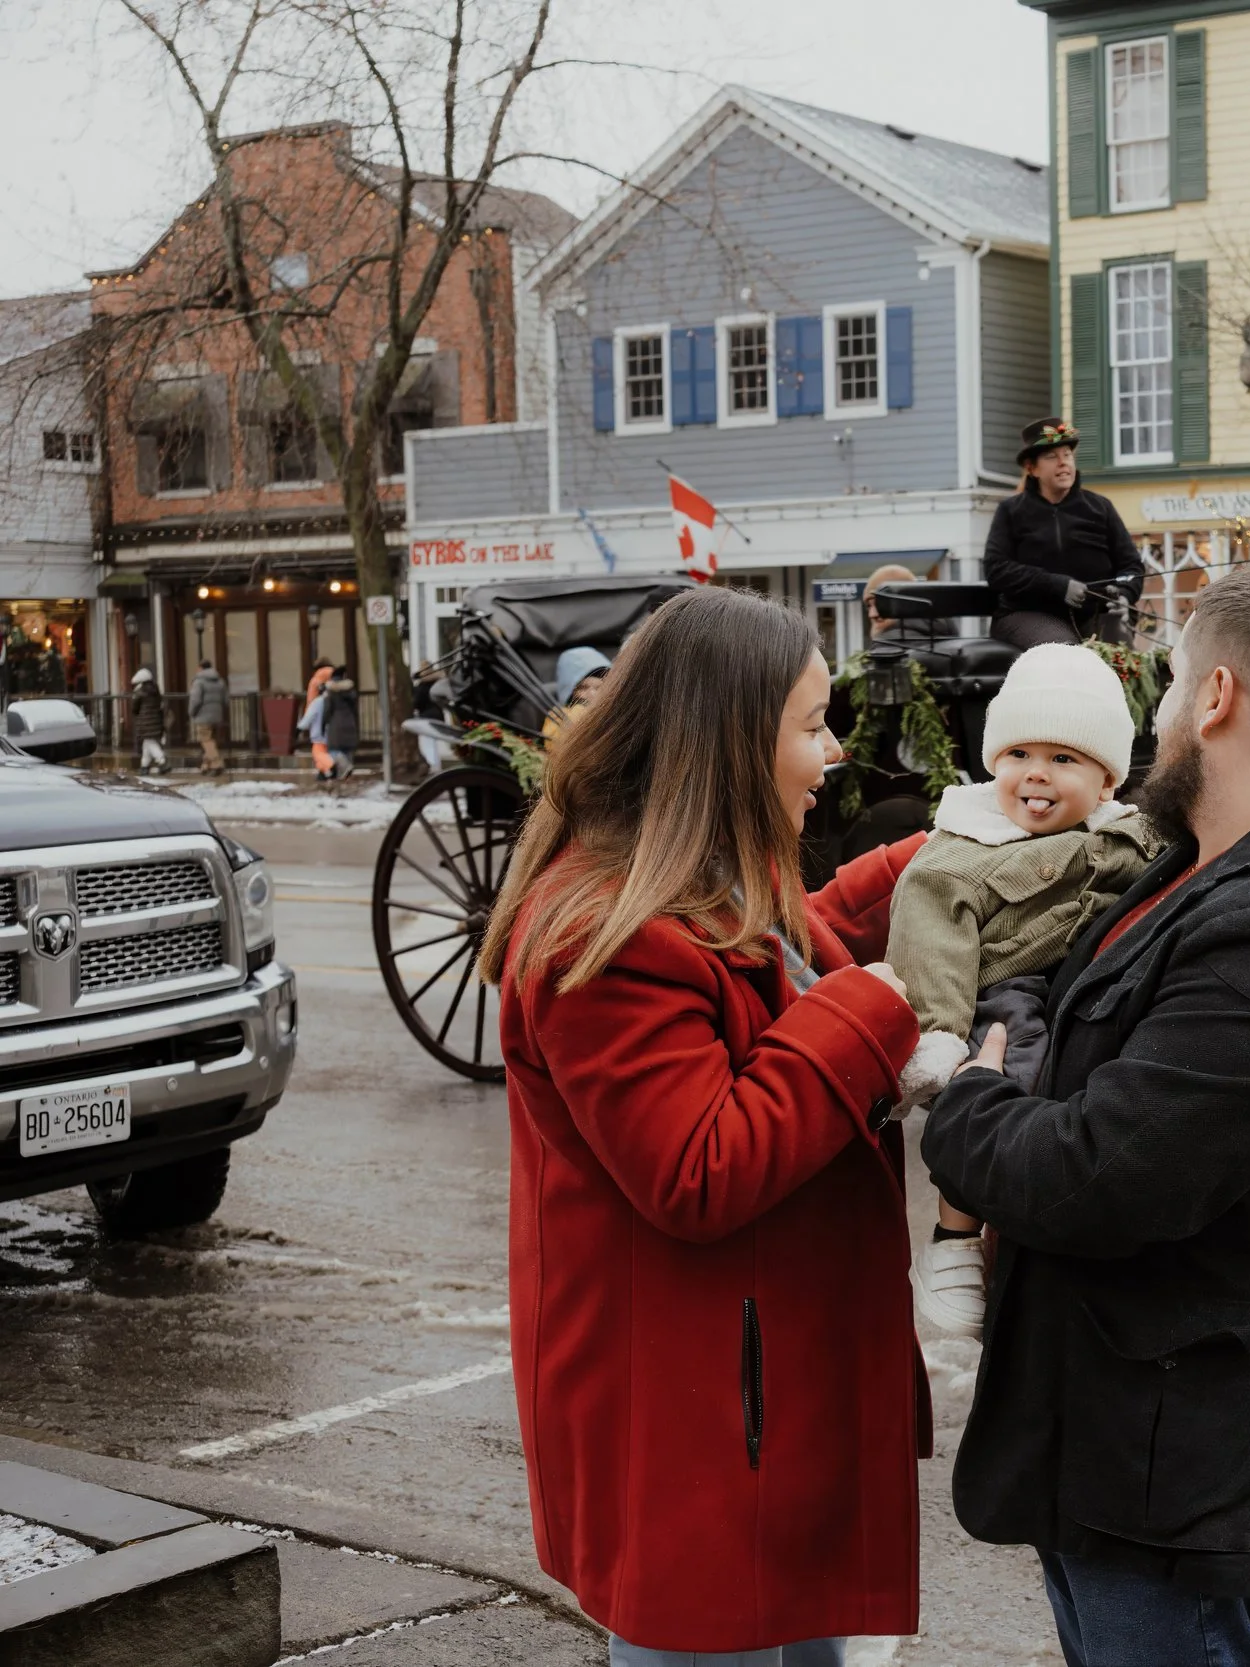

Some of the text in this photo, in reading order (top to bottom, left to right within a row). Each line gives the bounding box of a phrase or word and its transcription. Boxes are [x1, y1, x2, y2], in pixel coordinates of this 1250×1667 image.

[411, 539, 467, 568] GYROS
[492, 543, 520, 563] THE
[54, 1091, 98, 1106] ONTARIO
